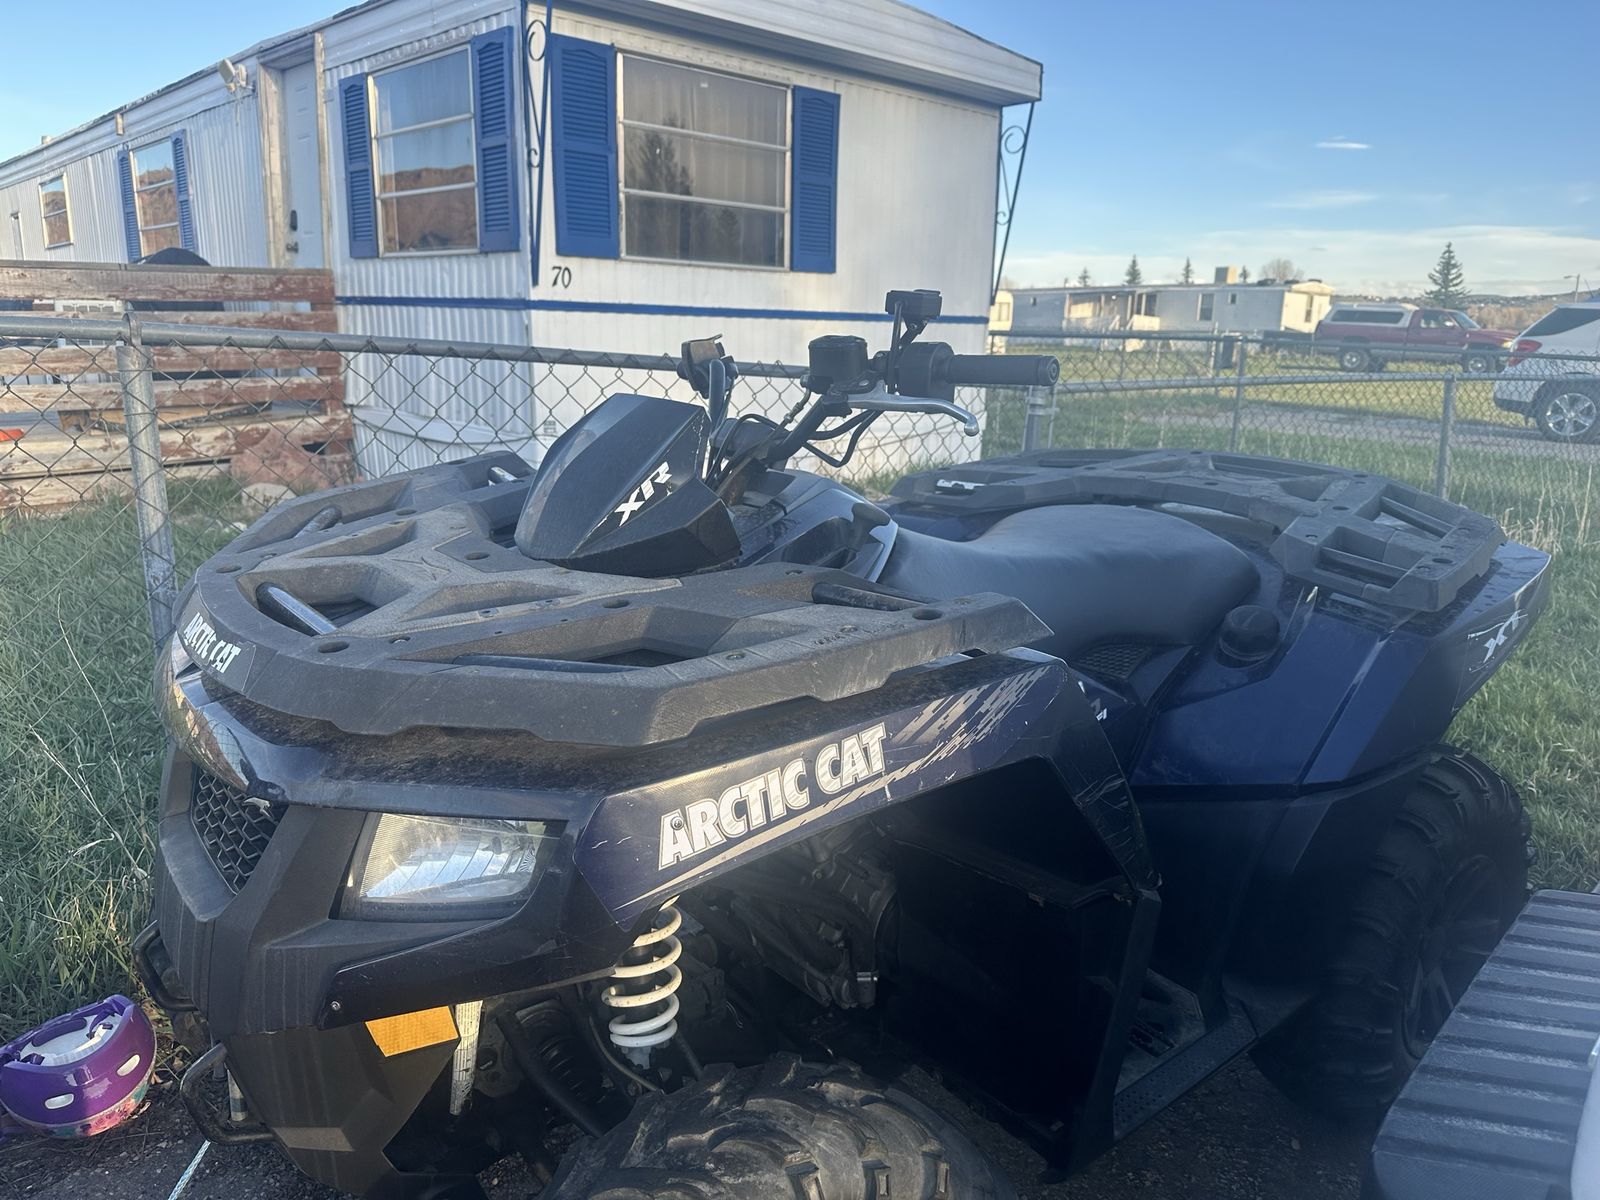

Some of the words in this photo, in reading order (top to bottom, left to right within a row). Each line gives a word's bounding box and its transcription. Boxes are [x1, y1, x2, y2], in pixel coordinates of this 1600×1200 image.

[552, 265, 572, 289] 70
[183, 611, 217, 659] ARCTIC
[208, 640, 242, 674] CAT
[658, 758, 811, 871] ARCTIC
[815, 722, 887, 795] CAT
